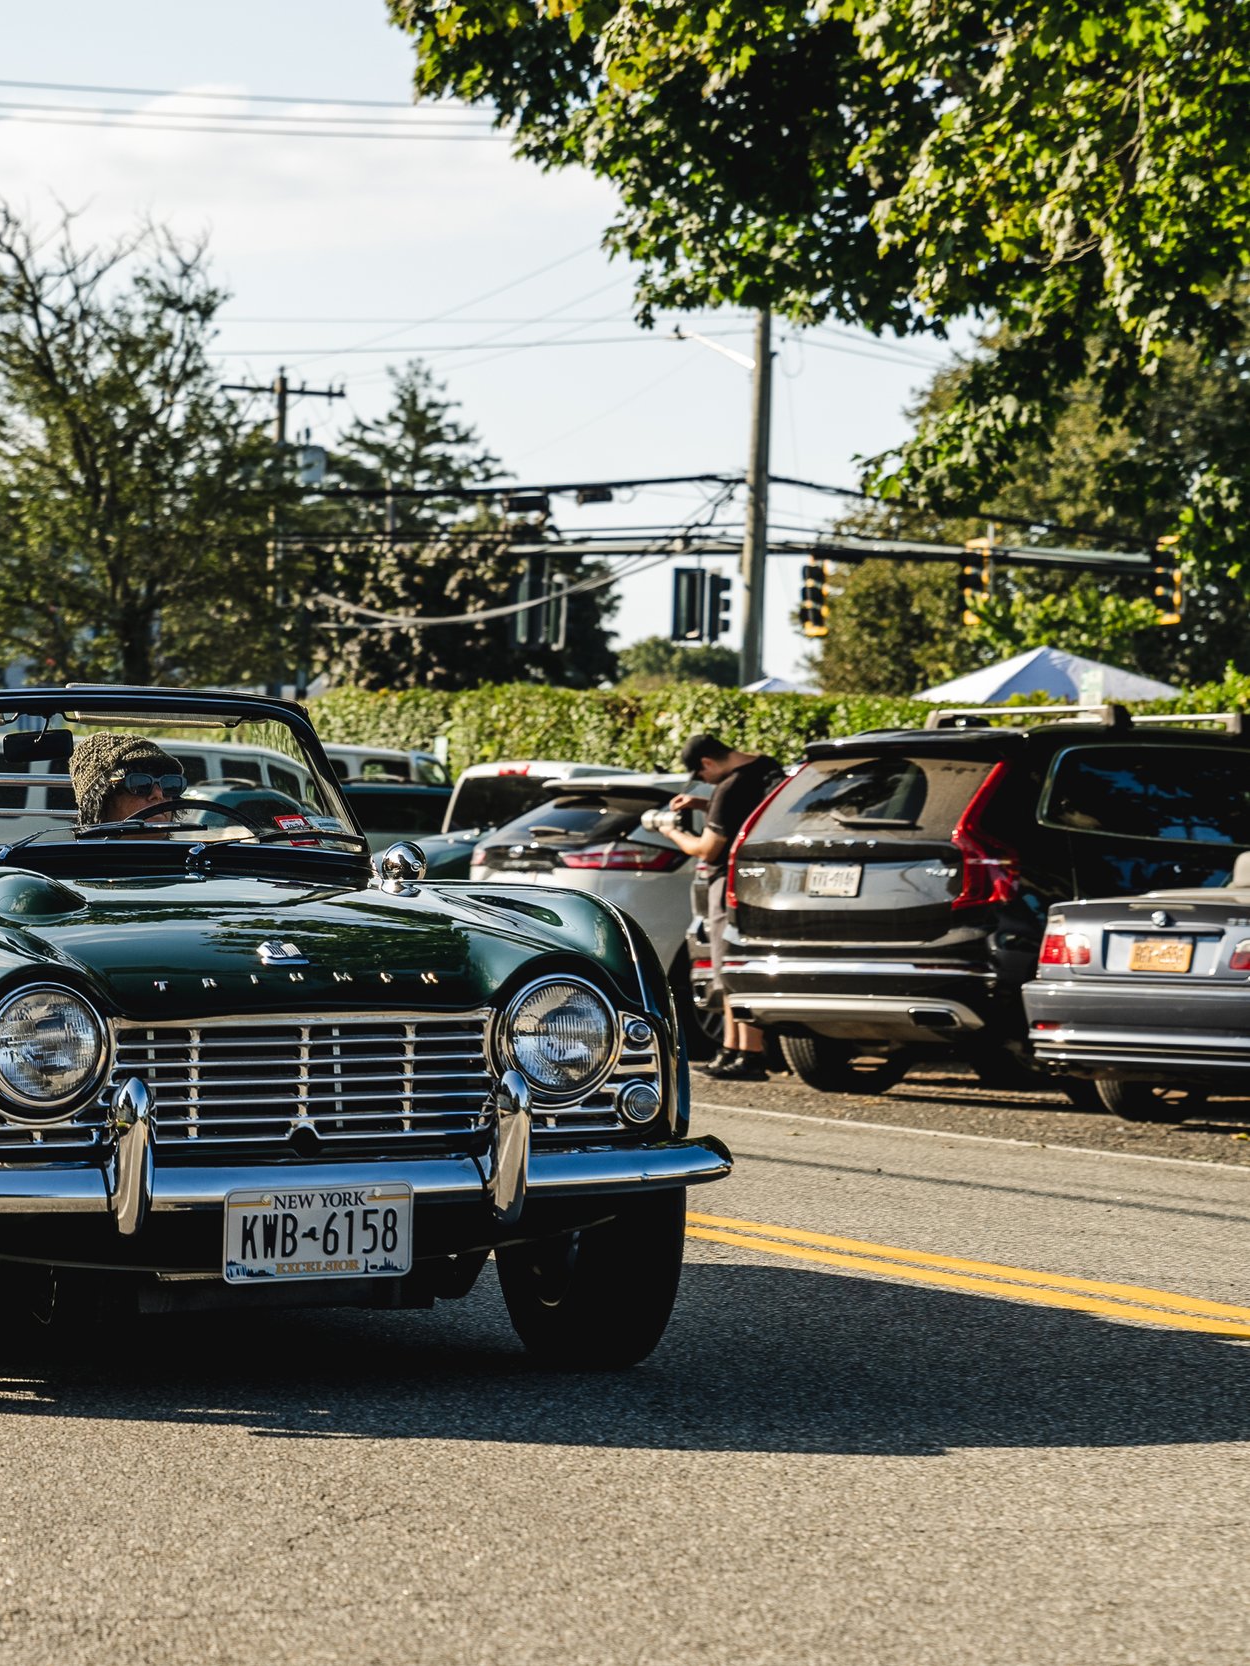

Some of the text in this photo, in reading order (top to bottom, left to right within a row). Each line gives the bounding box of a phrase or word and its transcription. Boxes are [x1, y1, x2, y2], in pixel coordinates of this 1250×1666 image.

[154, 971, 439, 992] TRIUMPH
[274, 1190, 367, 1210] NEW YORK
[241, 1207, 398, 1260] KWB 6158
[275, 1259, 360, 1275] EXCELSIOR
